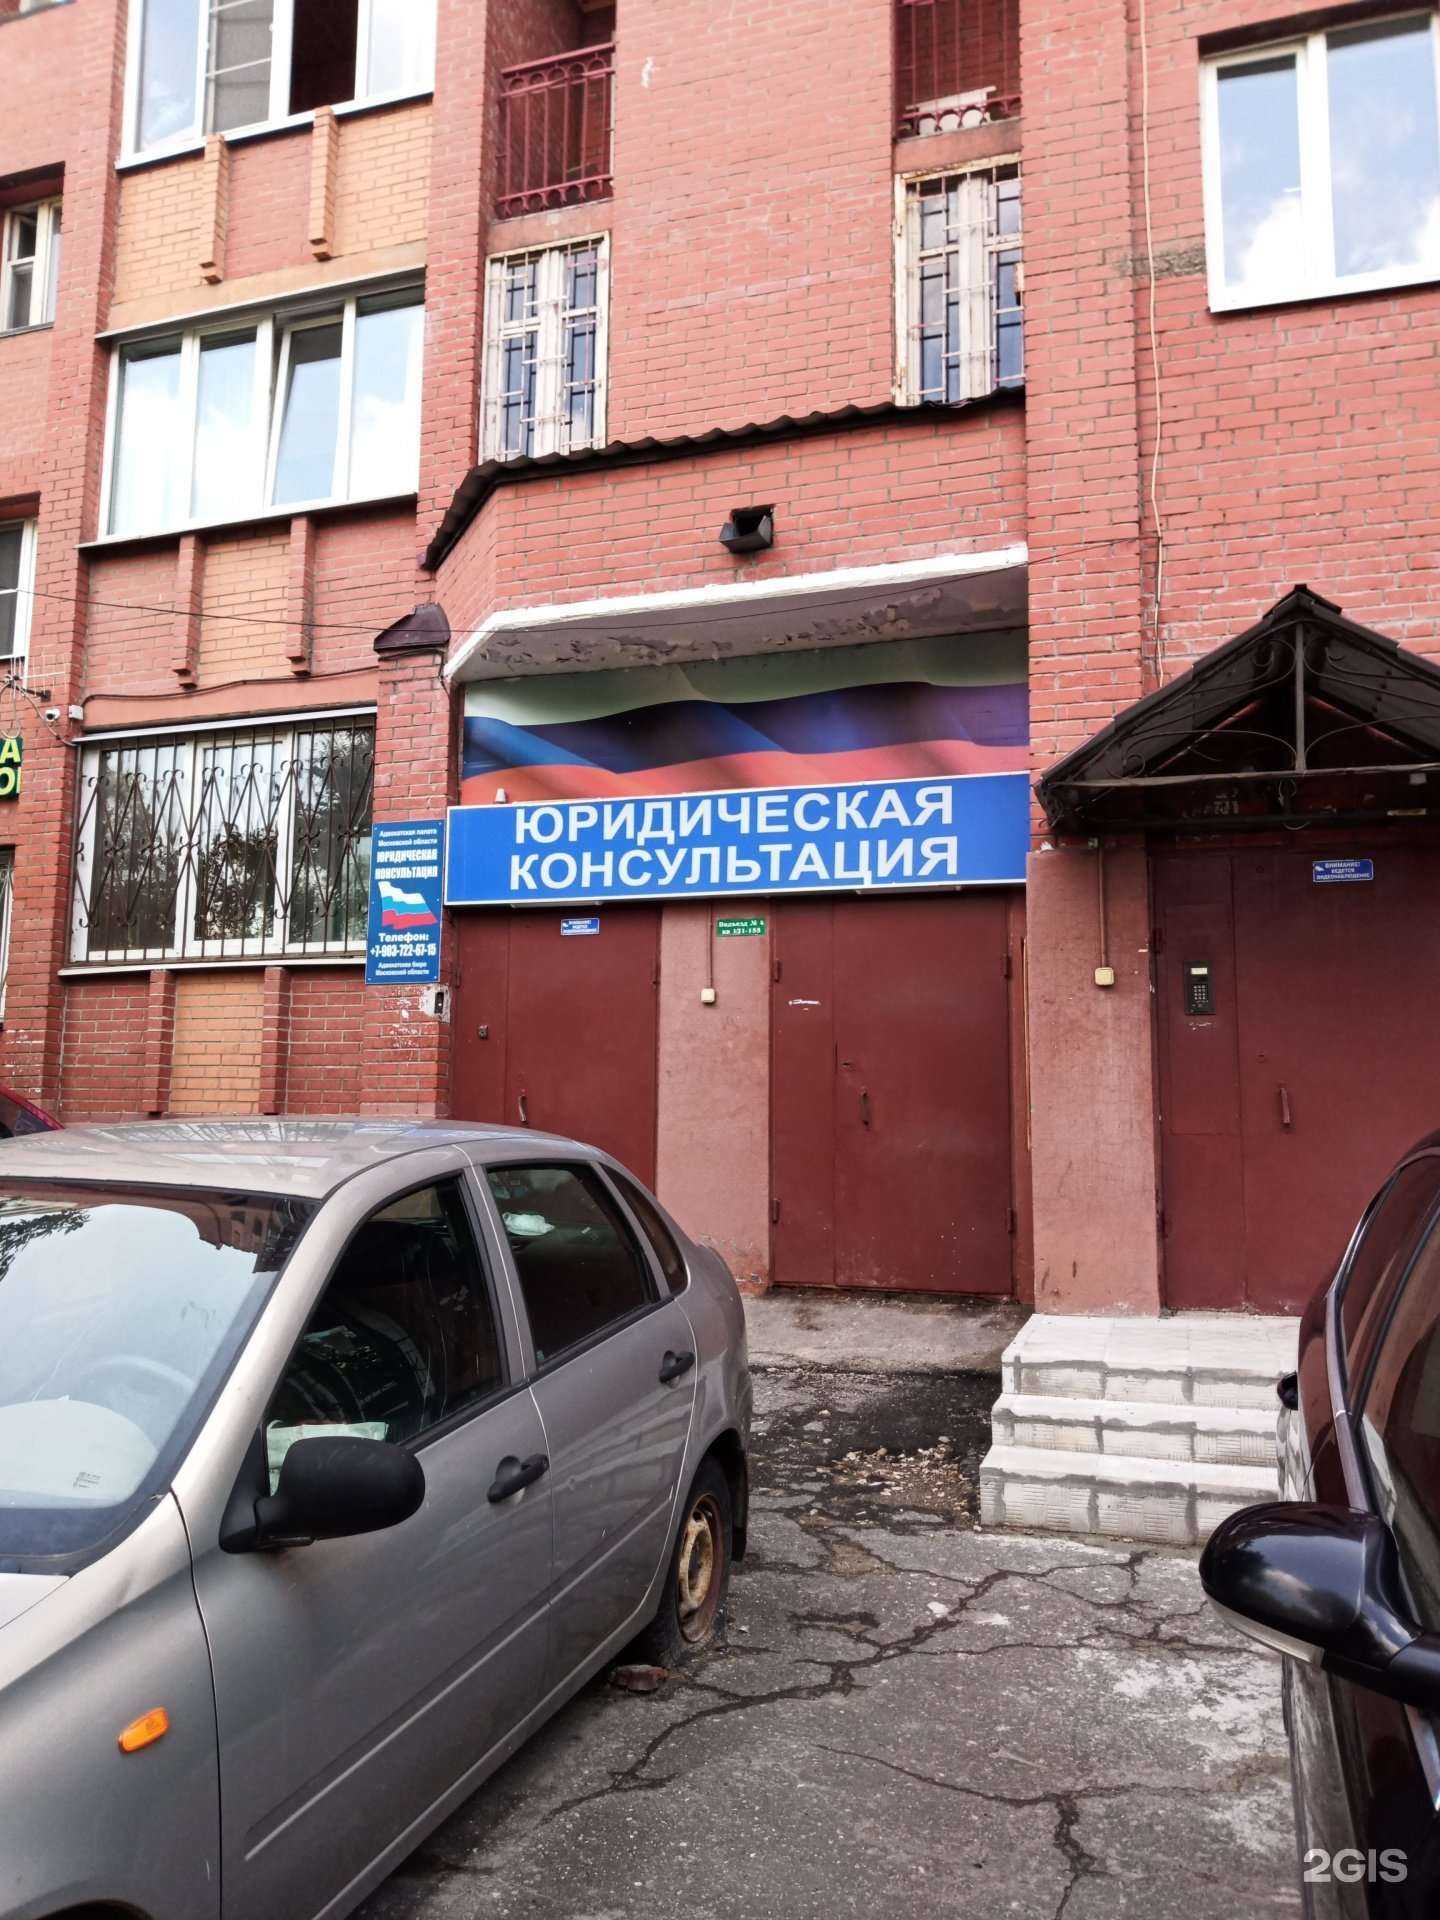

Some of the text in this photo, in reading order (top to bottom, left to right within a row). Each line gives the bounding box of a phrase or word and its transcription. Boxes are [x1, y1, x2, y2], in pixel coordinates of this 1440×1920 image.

[515, 785, 953, 847] ЮРИДИЧЕСКАЯ
[376, 848, 438, 863] ЮРИДИЧЕСКАЯ
[510, 835, 958, 891] КОНСУЛЬТАЦИЯ
[375, 865, 438, 880] КОНСУЛЬТАЦИЯ
[378, 931, 430, 944] Телефон:
